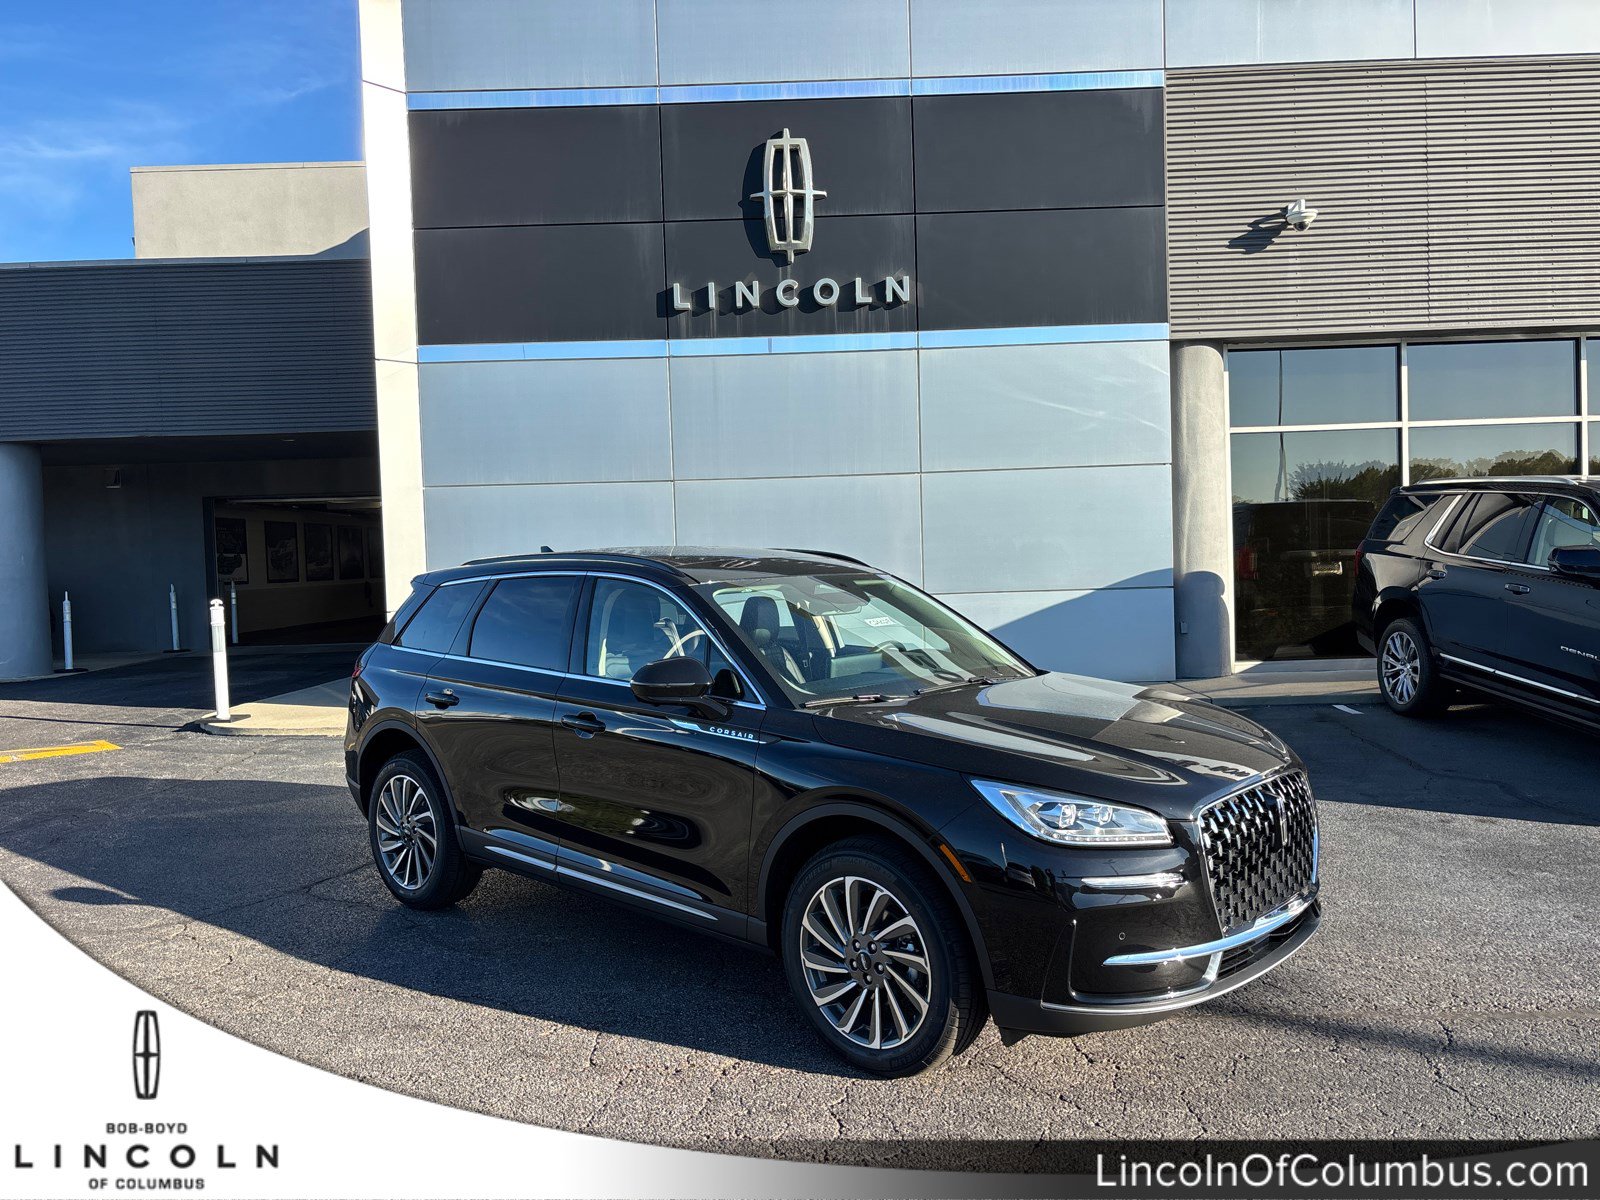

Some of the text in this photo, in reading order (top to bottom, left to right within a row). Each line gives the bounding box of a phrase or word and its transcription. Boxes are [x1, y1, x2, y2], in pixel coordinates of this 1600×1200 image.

[673, 275, 910, 310] LINCOLN
[1560, 645, 1600, 661] DENAL
[709, 726, 754, 740] CORSAIR
